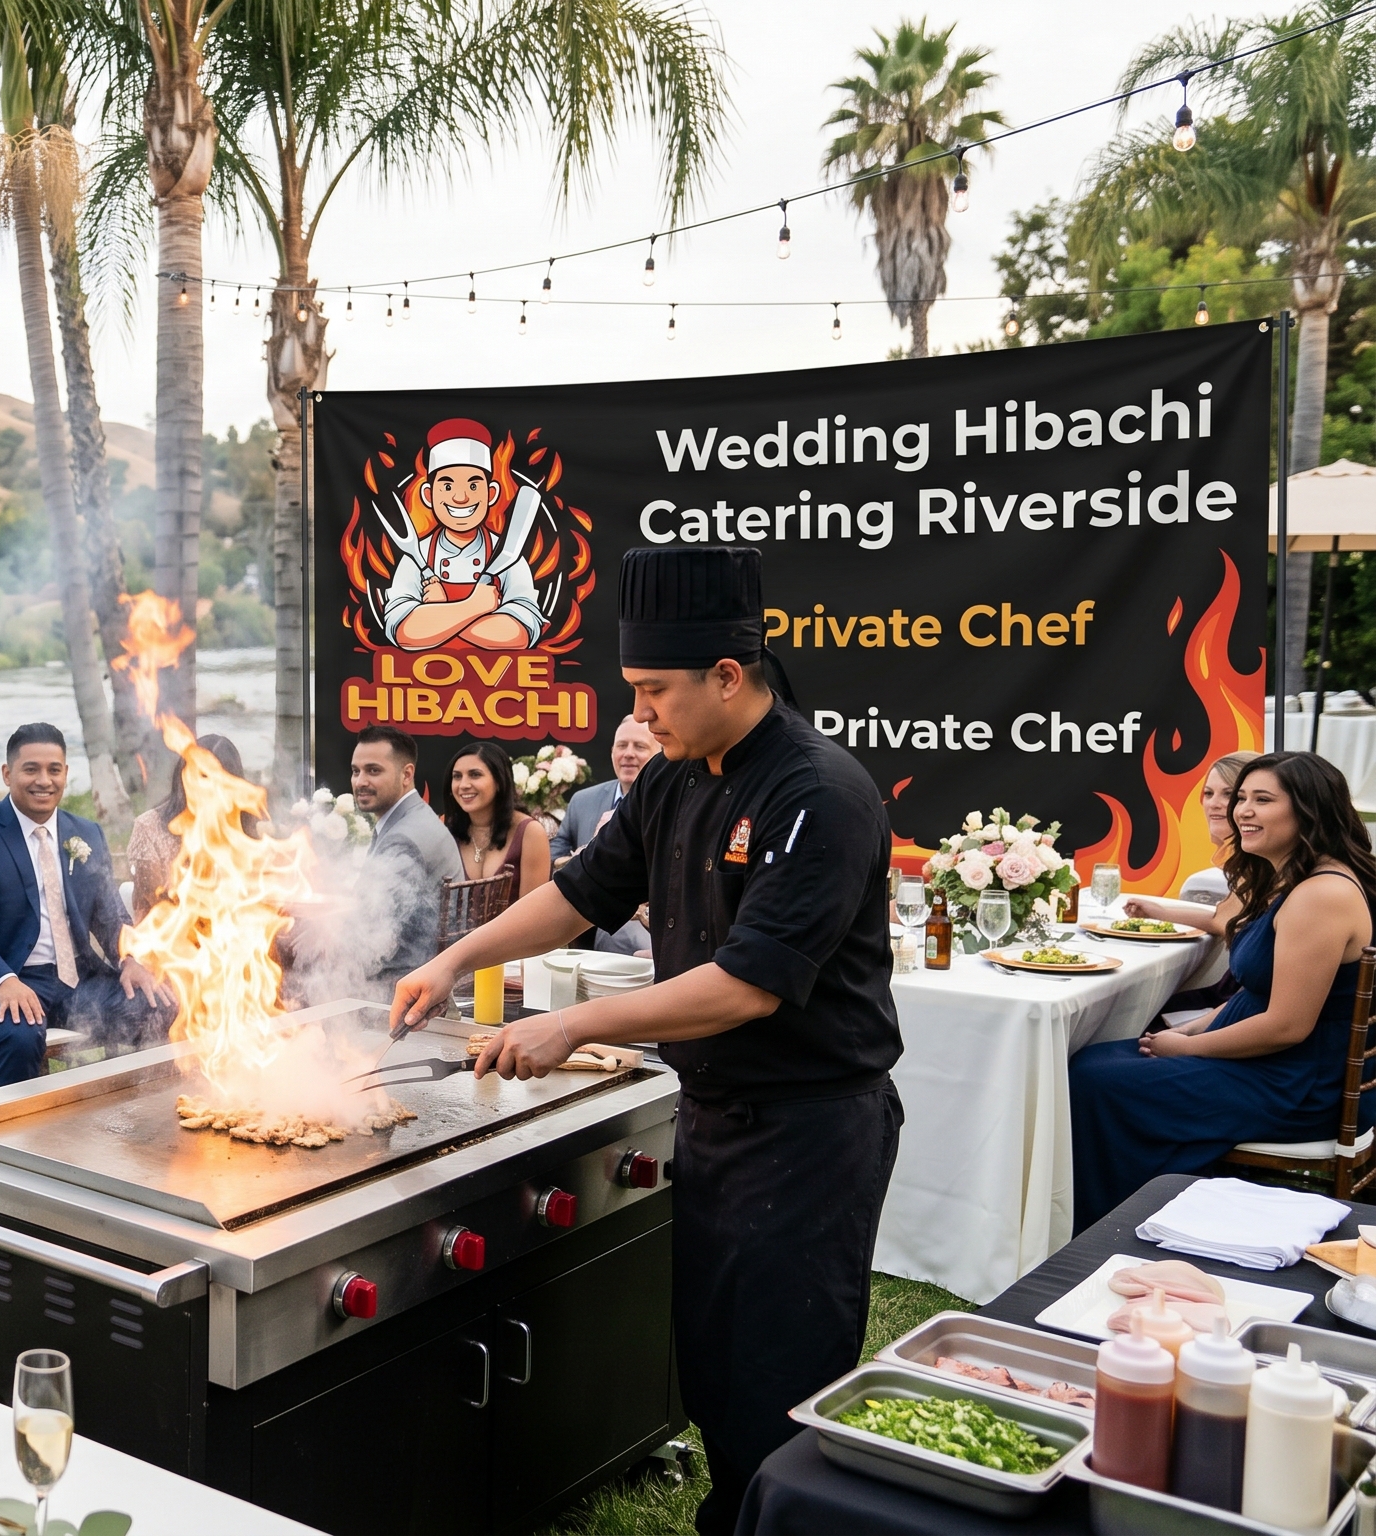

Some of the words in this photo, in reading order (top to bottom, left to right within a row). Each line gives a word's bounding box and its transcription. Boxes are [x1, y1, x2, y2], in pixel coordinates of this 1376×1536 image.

[656, 415, 929, 472] Wedding
[956, 382, 1213, 456] Hibachi
[639, 490, 894, 550] Catering
[918, 469, 1238, 536] Riverside
[764, 603, 942, 648] Private
[959, 600, 1096, 647] Chef
[381, 653, 550, 689] LOVE
[347, 685, 589, 729] HIBACHI
[814, 706, 994, 751] Private
[1010, 711, 1143, 754] Chef
